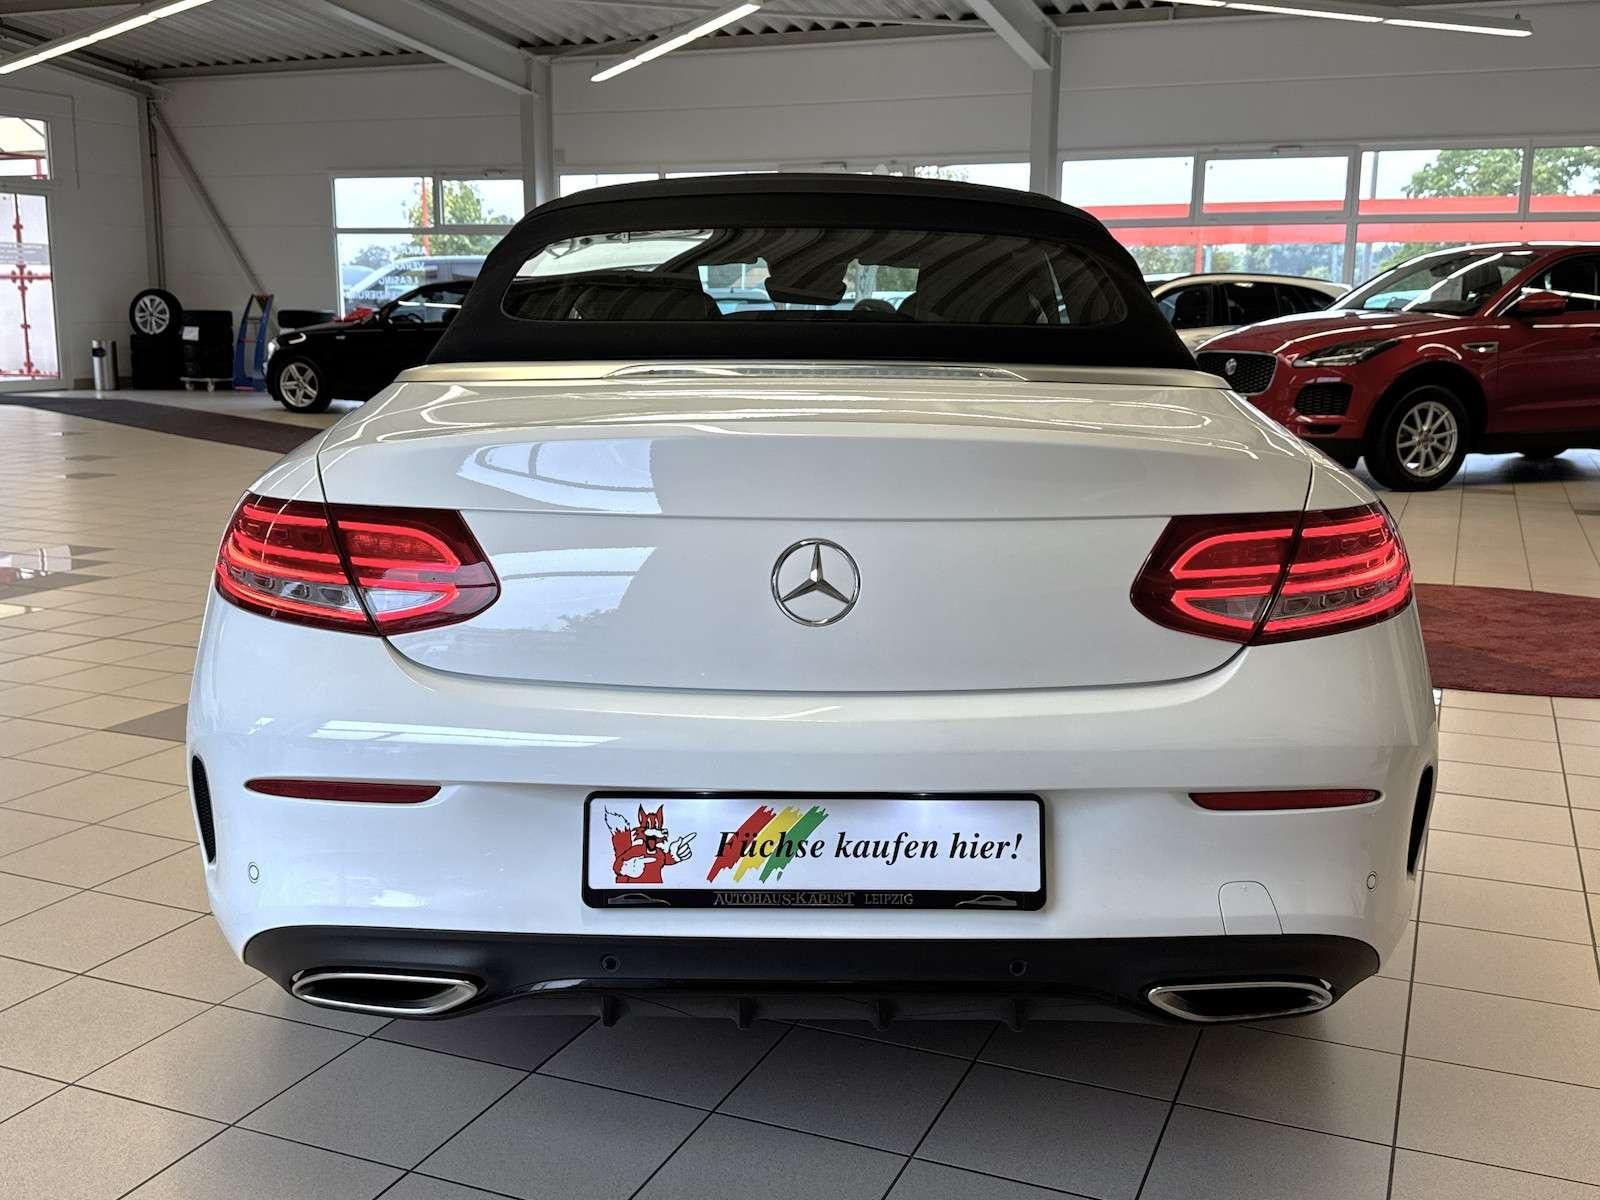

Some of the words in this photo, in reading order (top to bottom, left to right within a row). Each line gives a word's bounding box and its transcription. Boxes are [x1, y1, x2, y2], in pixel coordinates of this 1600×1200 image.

[714, 831, 825, 858] Füchse
[834, 831, 938, 865] kaufen
[949, 832, 1022, 859] hier!
[864, 893, 914, 905] LEIPZIG
